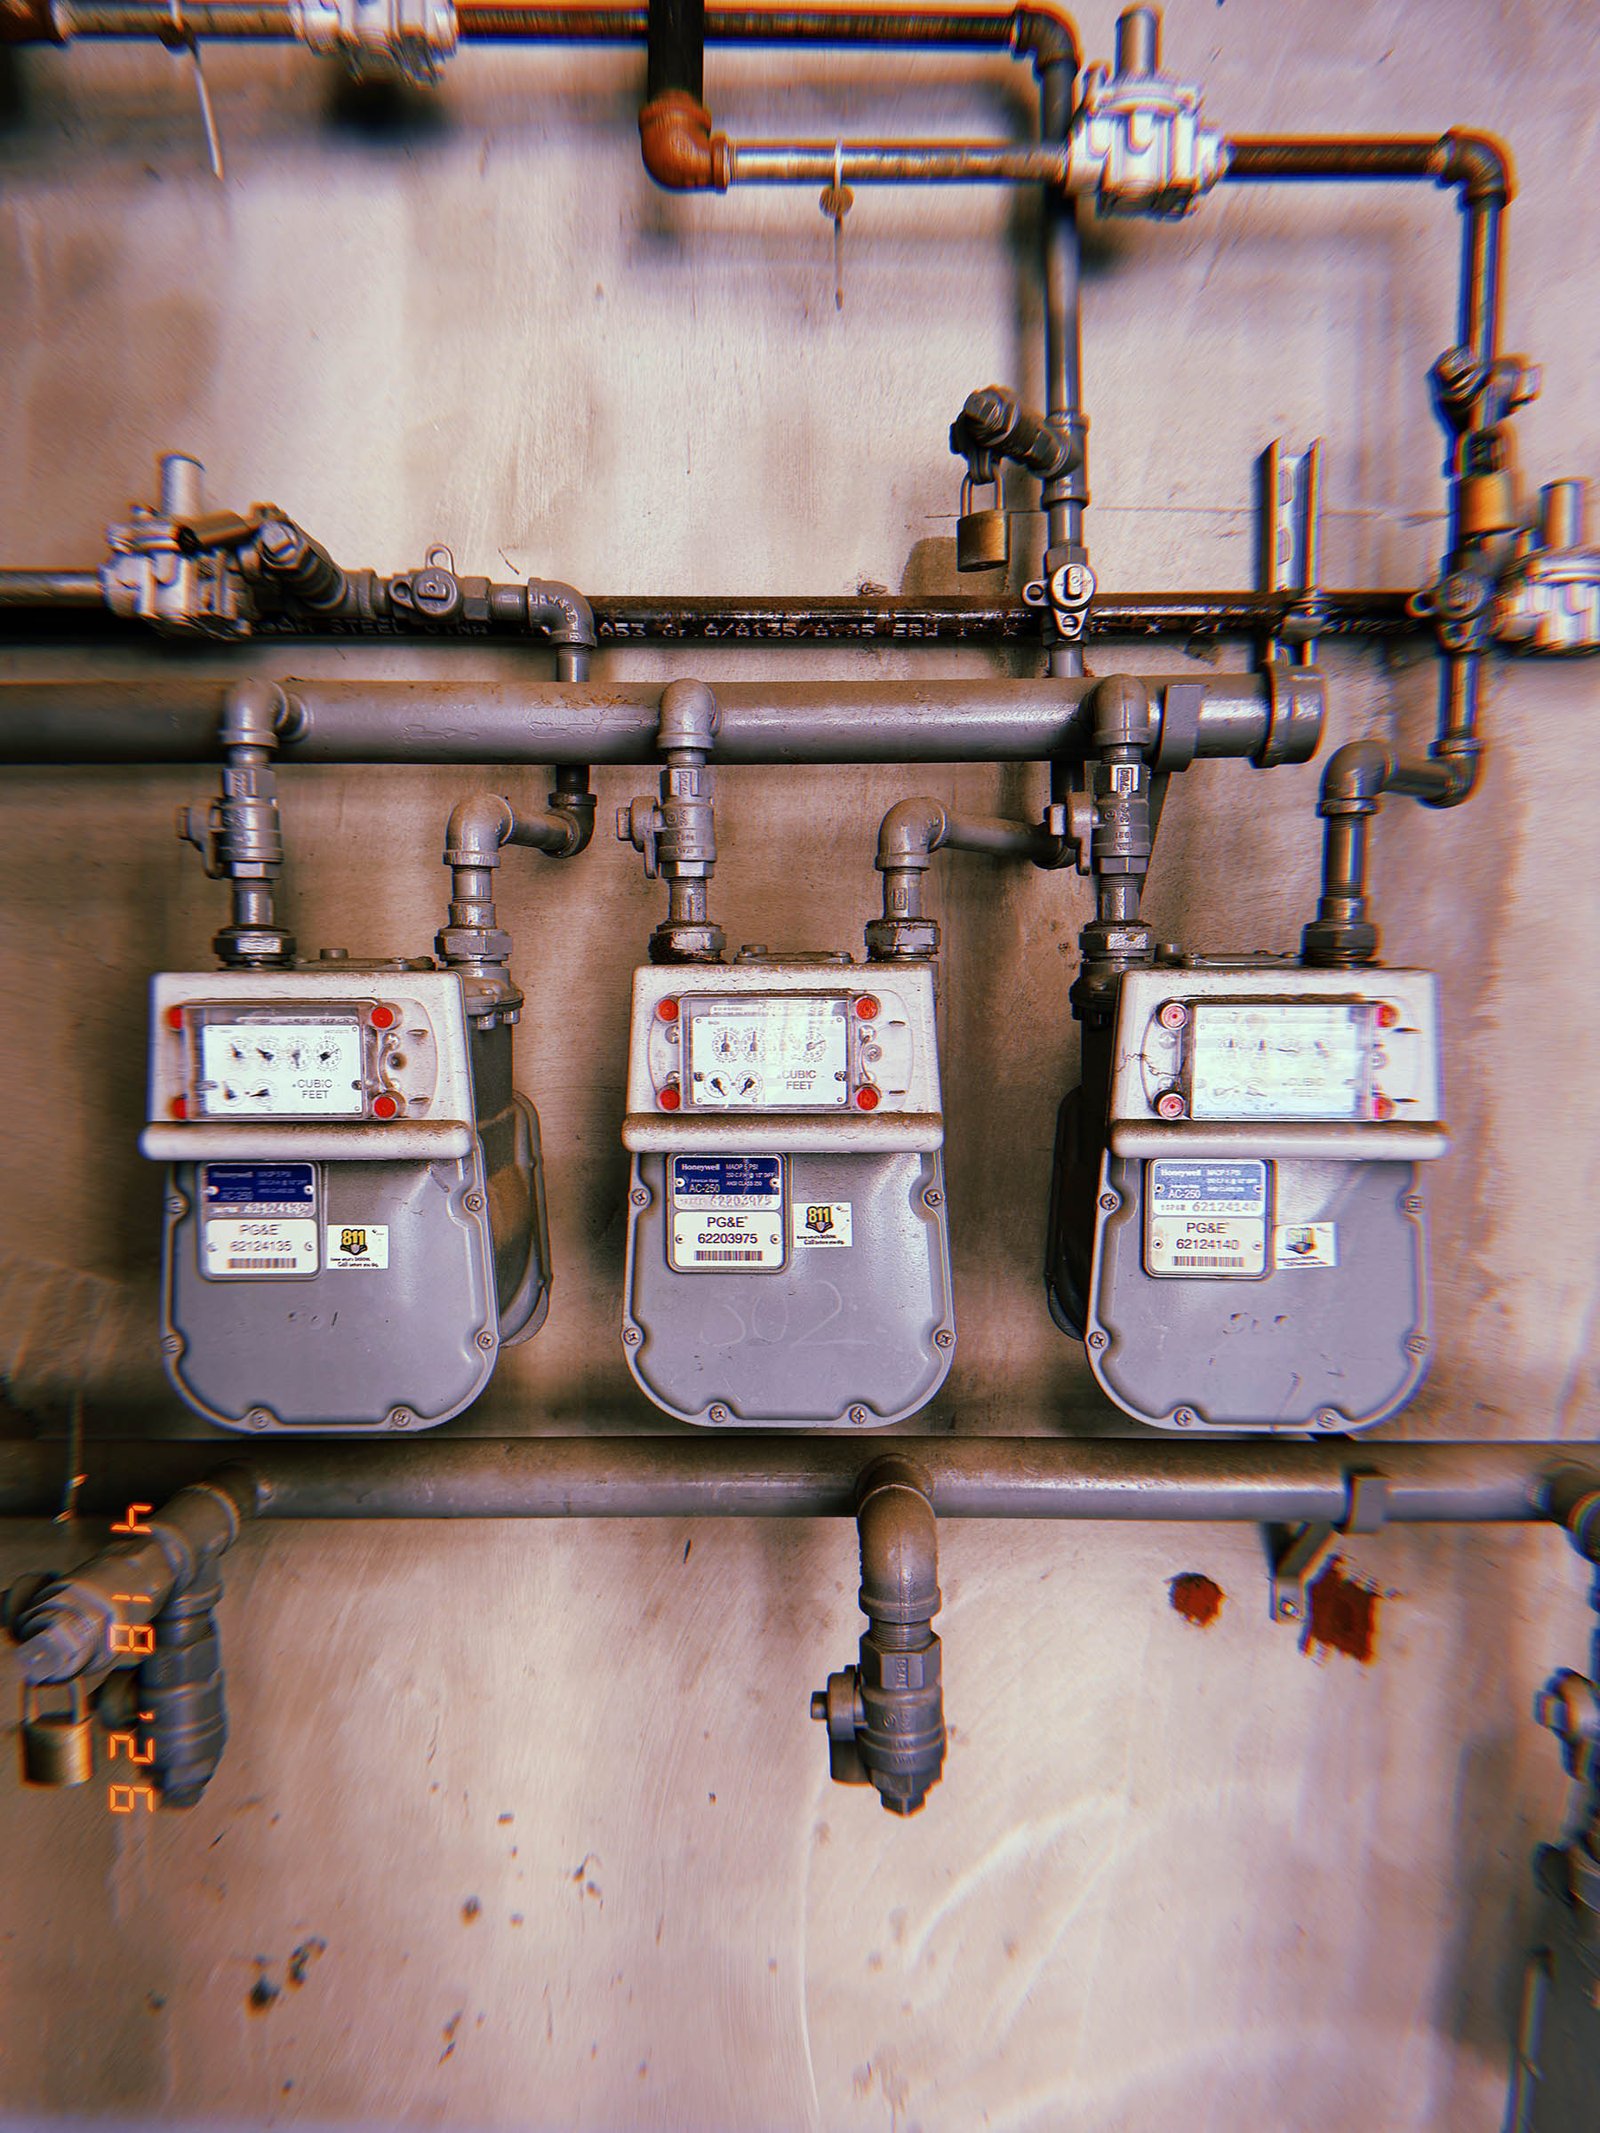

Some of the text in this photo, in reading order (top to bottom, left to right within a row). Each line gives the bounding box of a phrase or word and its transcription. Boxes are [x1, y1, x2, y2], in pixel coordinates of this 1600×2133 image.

[598, 621, 648, 638] A53
[782, 1070, 817, 1080] CUBIC
[297, 1079, 332, 1089] CUBIC
[786, 1081, 813, 1090] FEET
[302, 1090, 329, 1100] FEET
[681, 1163, 720, 1172] Honeywell
[1160, 1169, 1202, 1178] Honeywell
[689, 1183, 721, 1194] AC-250
[1167, 1189, 1202, 1199] AC-250
[1192, 1201, 1259, 1212] 62124140
[807, 1205, 831, 1224] 811
[707, 1216, 746, 1228] PG&E
[239, 1223, 281, 1236] PG&E
[1186, 1222, 1227, 1235] PG&E
[342, 1229, 366, 1247] 811
[698, 1233, 758, 1245] 62203975
[230, 1240, 292, 1253] 62124135
[1176, 1238, 1240, 1251] 62124140
